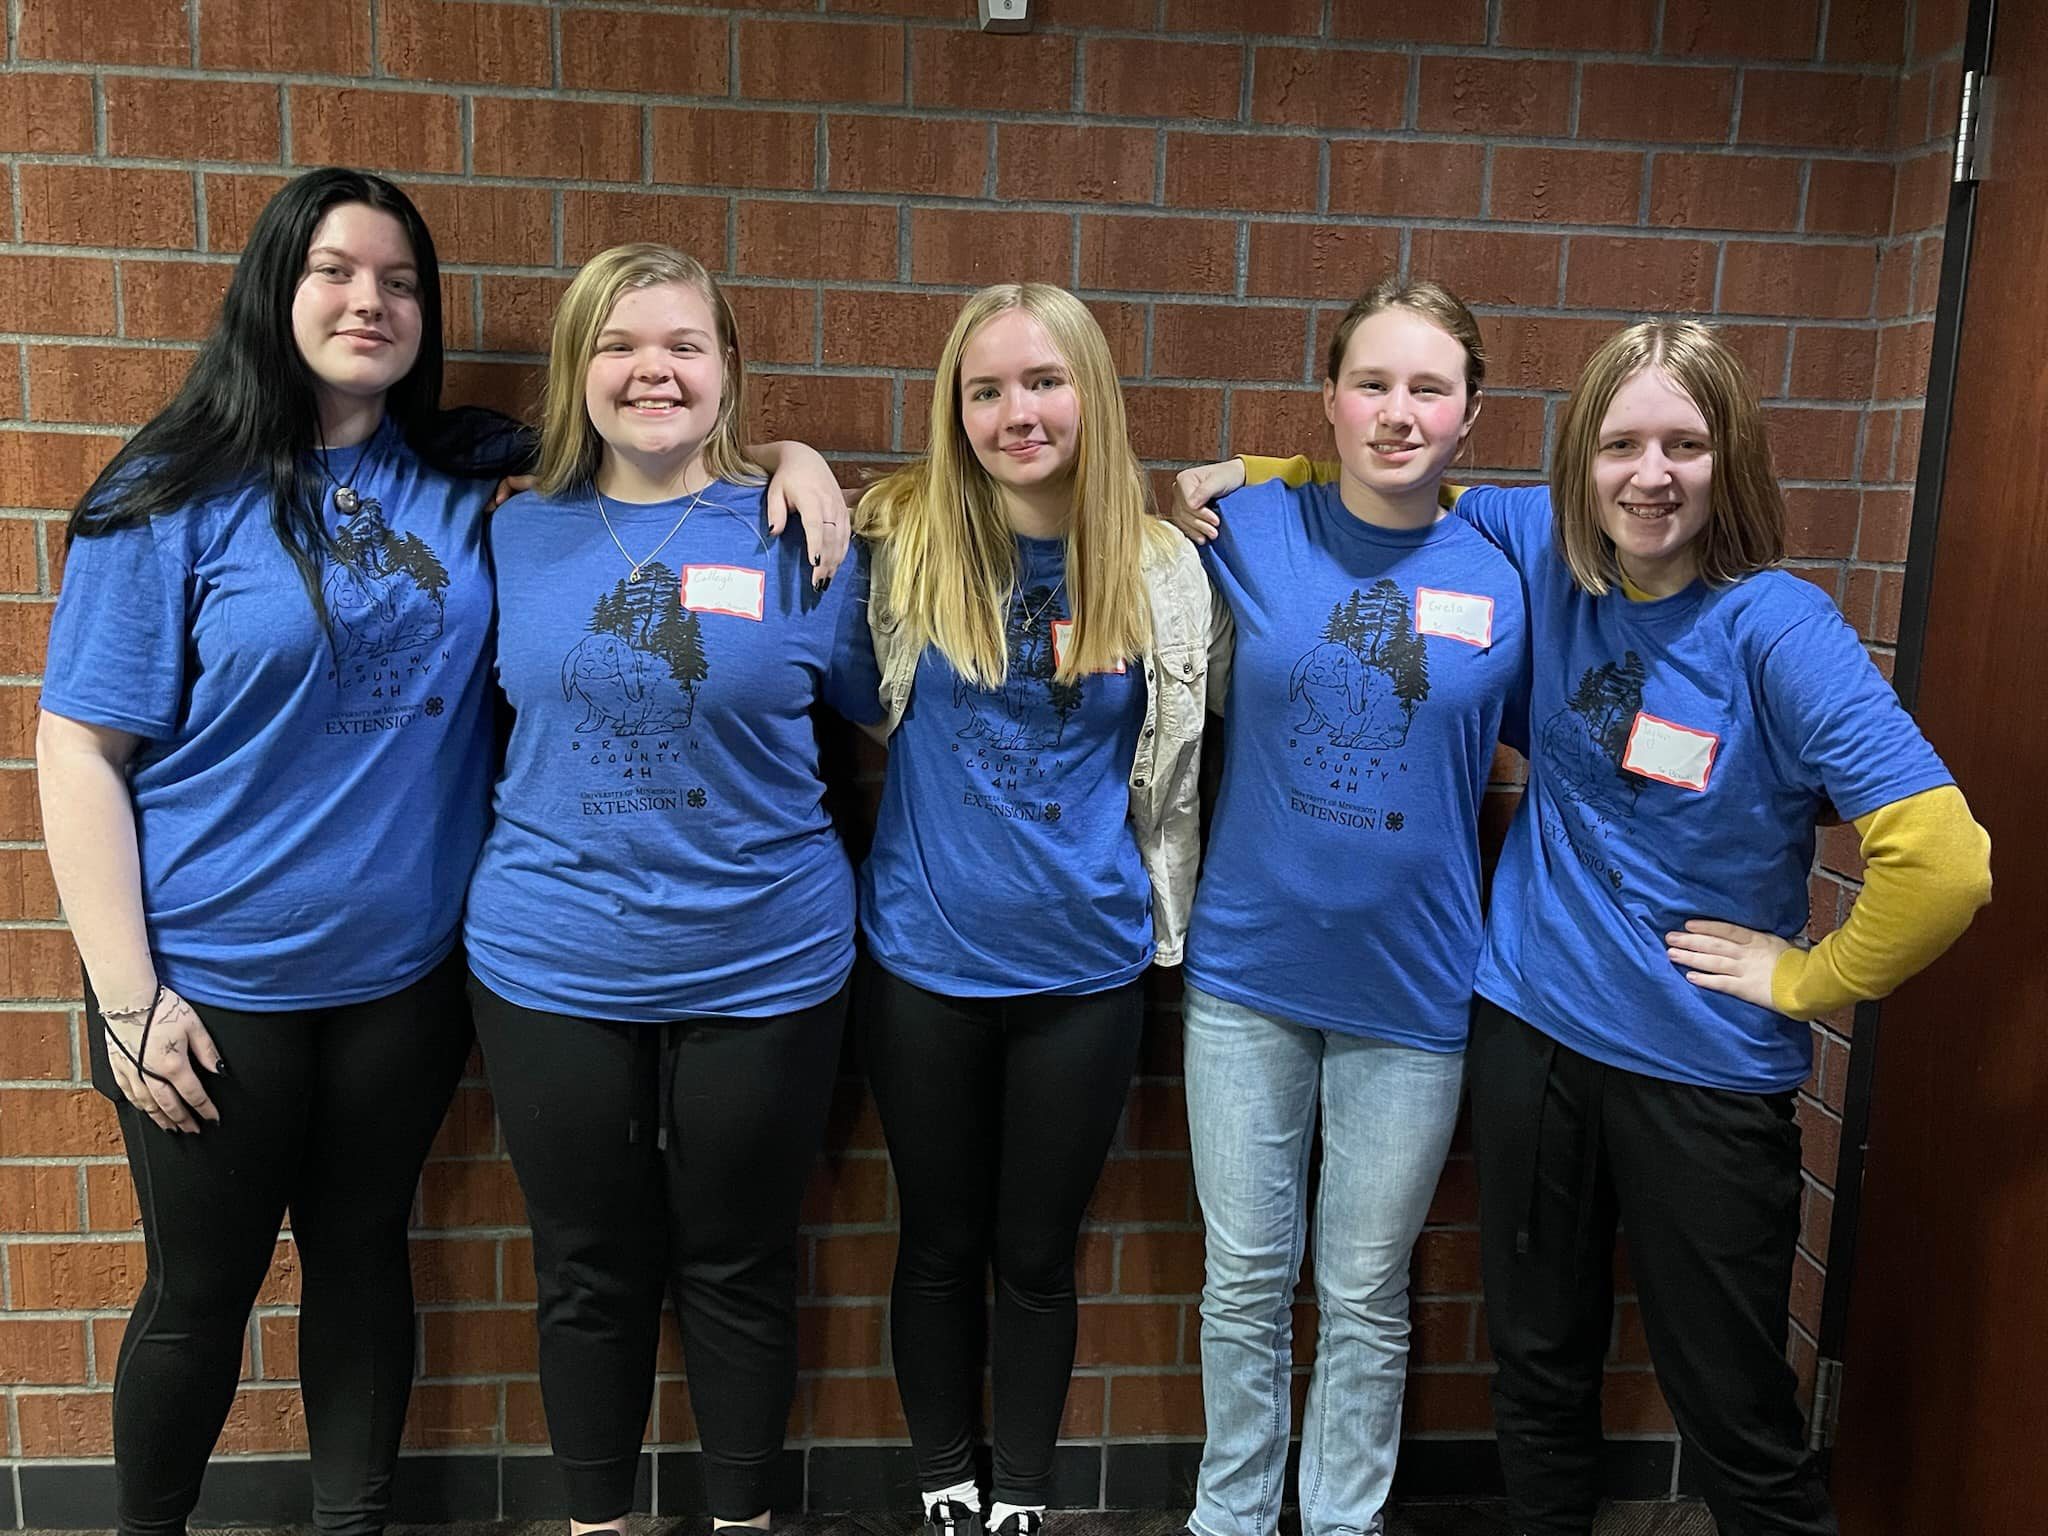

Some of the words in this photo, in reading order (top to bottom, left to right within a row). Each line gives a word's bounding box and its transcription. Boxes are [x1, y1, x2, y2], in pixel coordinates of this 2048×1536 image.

[572, 740, 699, 751] BROWN
[952, 743, 1064, 769] BROWN
[1289, 739, 1408, 772] BROWN
[591, 752, 681, 765] COUNTY
[966, 759, 1047, 778] COUNTY
[1303, 757, 1389, 782] COUNTY
[583, 797, 677, 816] EXTENSION
[1291, 796, 1376, 830] EXTENSION
